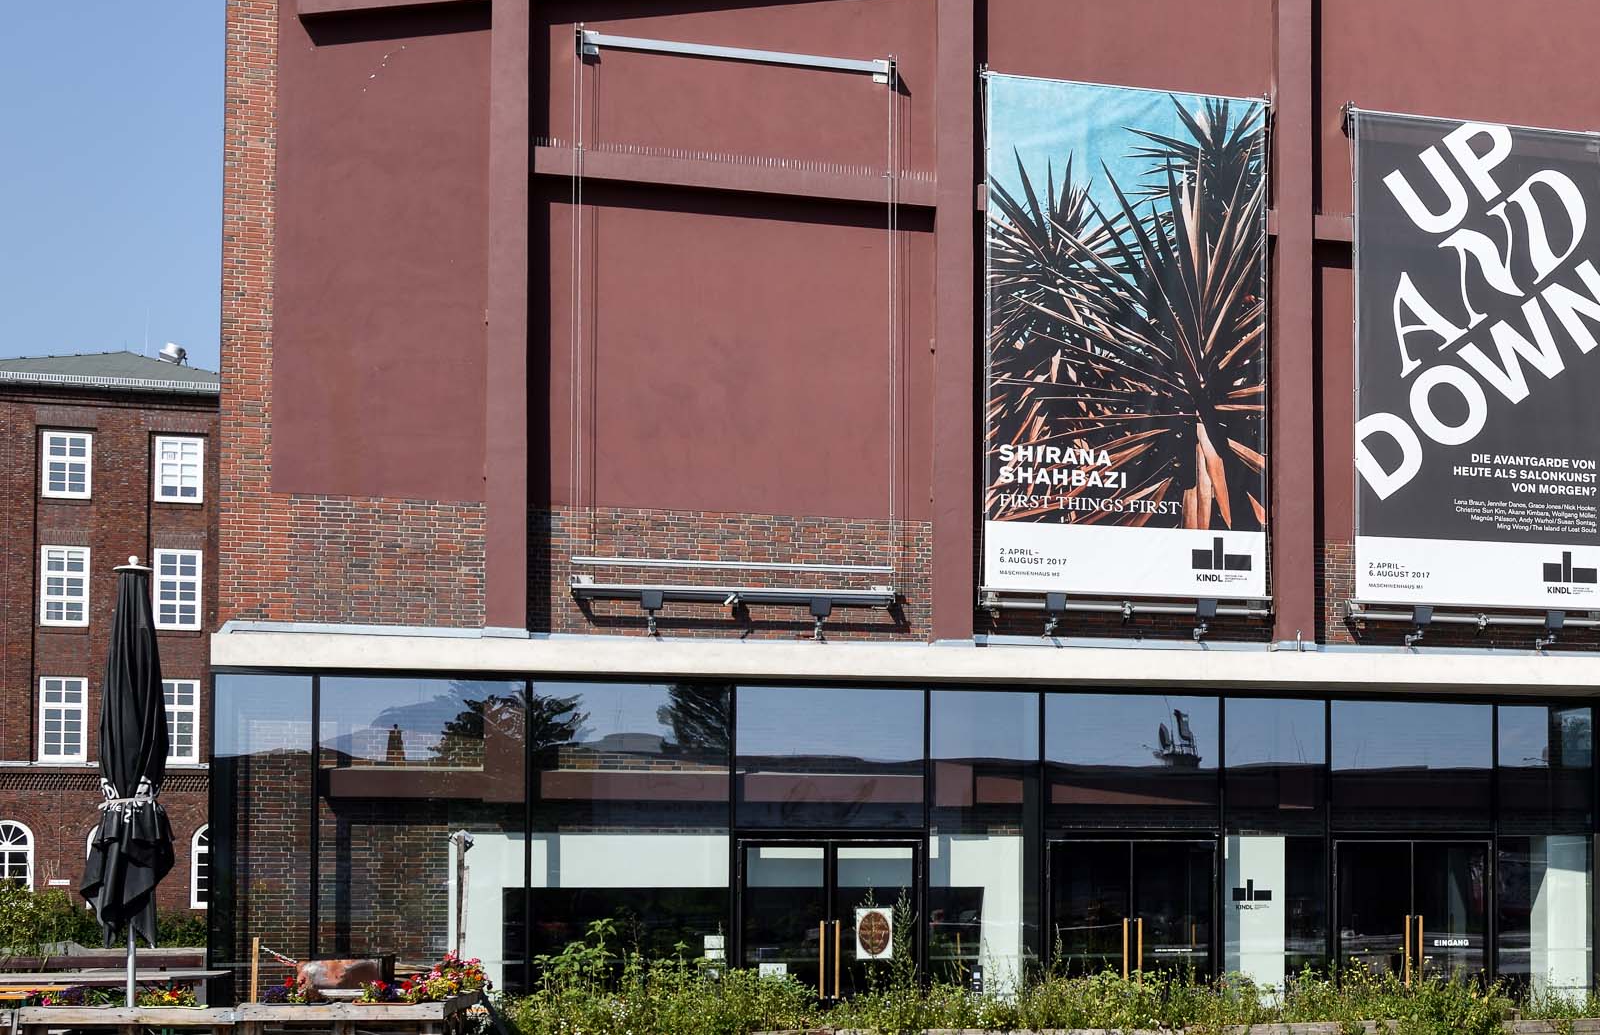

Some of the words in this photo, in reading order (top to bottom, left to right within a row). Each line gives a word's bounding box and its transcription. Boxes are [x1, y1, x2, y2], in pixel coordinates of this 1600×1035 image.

[1382, 122, 1512, 233] UP
[1393, 169, 1587, 378] AND
[999, 444, 1112, 466] SHIRANA
[1471, 453, 1491, 464] DIE
[1493, 455, 1569, 468] AVANTGARDE
[1571, 459, 1596, 470] VON
[999, 466, 1127, 489] SHAHBAZI
[1453, 466, 1491, 478] HEUTE
[1494, 468, 1517, 479] ALS
[1519, 470, 1597, 483] SALONKUNST
[1511, 483, 1536, 493] VON
[1538, 484, 1597, 496] MORGEN?
[1000, 493, 1051, 509] FIRST
[1055, 496, 1123, 512] THINGS
[1129, 499, 1180, 515] FIRST
[1468, 499, 1486, 507] Braun,
[1456, 506, 1480, 514] Christine
[1552, 510, 1578, 519] Wolfgang
[1008, 556, 1044, 564] AUGUST
[1196, 574, 1223, 582] KINDL
[1547, 586, 1572, 594] KINDL
